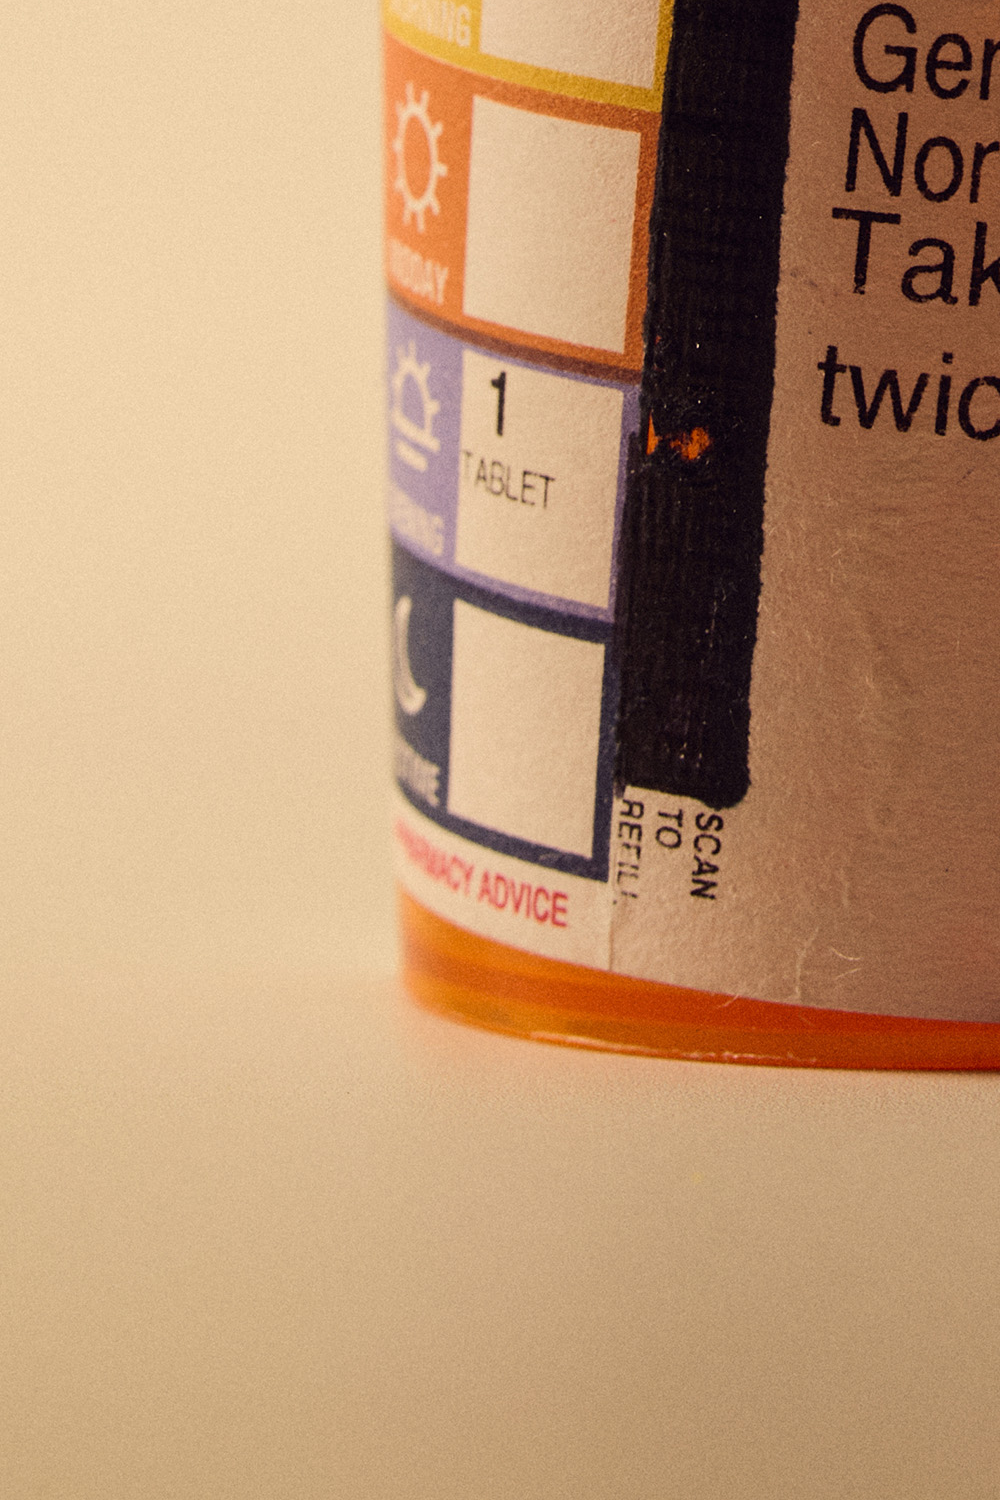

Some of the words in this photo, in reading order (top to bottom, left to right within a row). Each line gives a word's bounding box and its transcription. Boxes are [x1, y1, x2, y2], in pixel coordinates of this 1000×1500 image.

[490, 370, 507, 437] 1
[461, 449, 557, 511] TABLET
[655, 808, 684, 850] TO
[690, 811, 725, 901] SCAN
[478, 868, 569, 928] ADVICE
